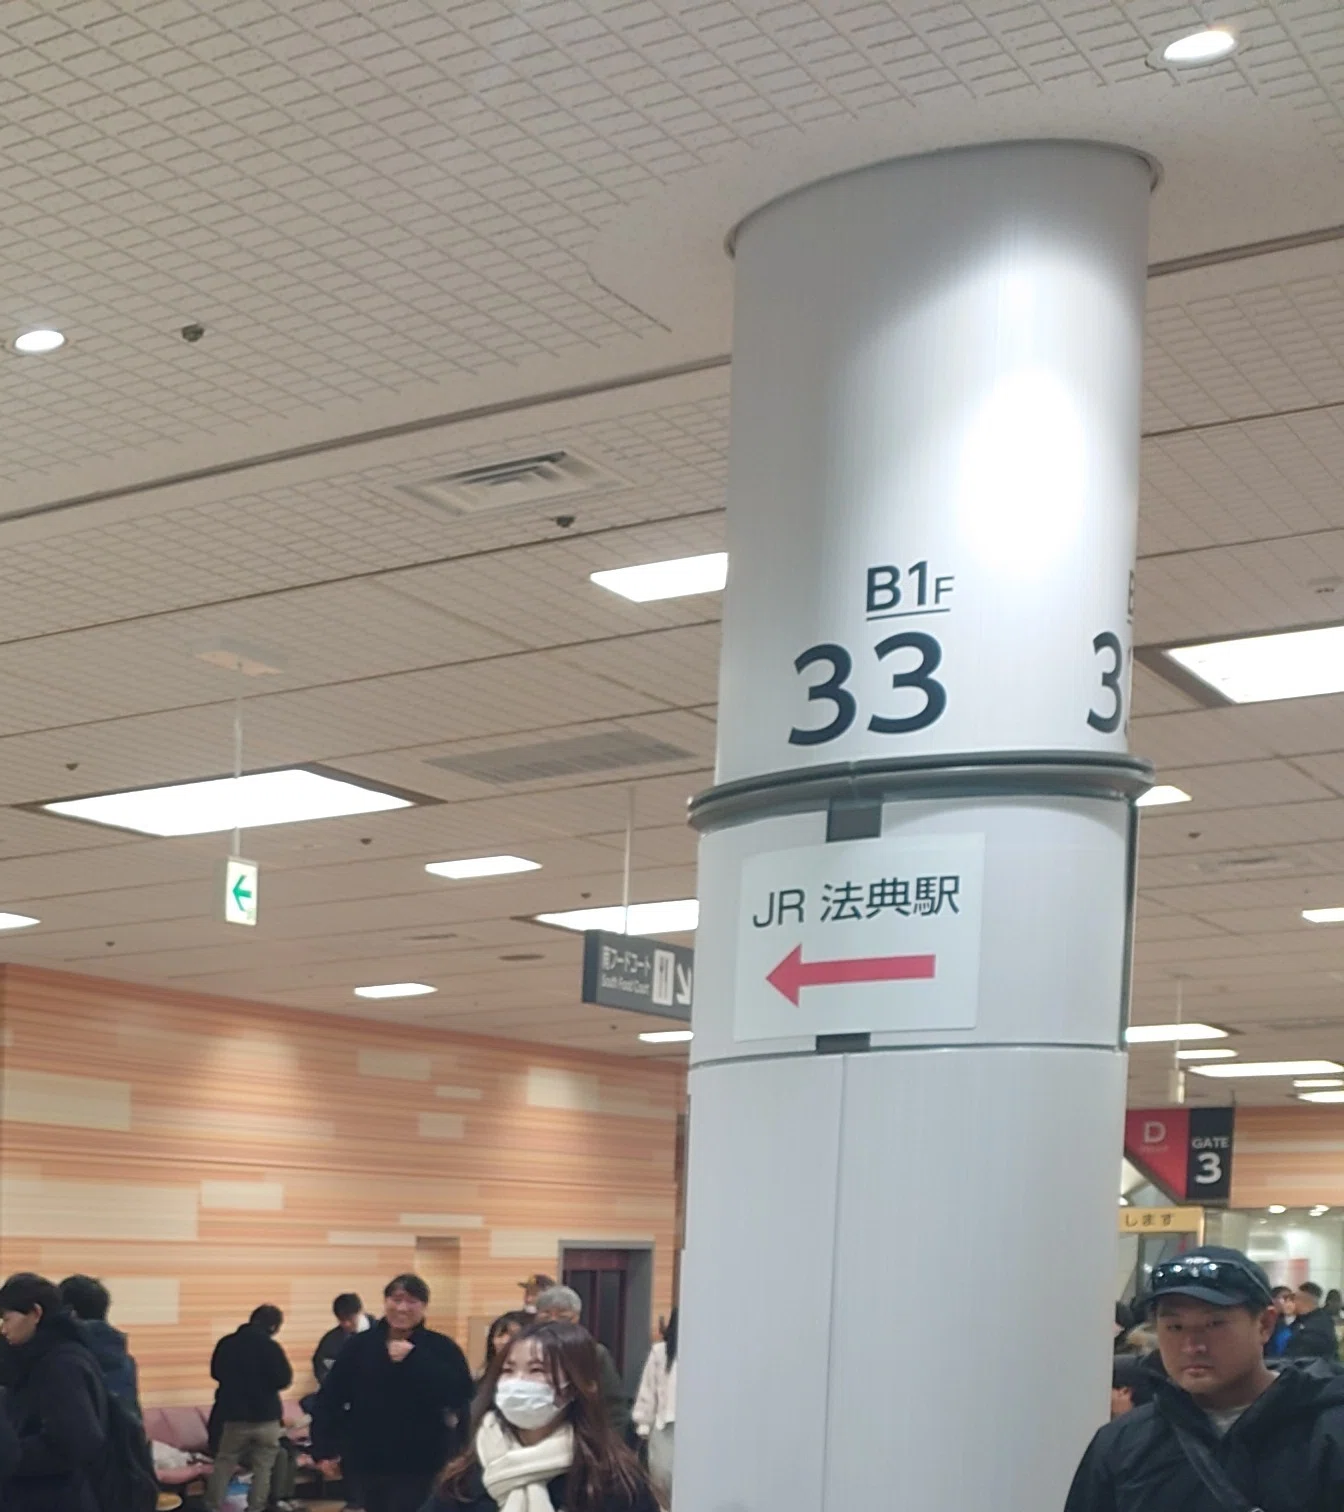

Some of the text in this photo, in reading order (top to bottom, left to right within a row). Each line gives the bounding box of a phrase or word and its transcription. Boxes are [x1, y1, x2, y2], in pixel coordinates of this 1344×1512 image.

[866, 561, 955, 612] B1F
[788, 631, 948, 746] 33
[1086, 631, 1128, 734] 3
[752, 875, 961, 928] JR 法典駅
[1144, 1121, 1166, 1143] D
[1191, 1137, 1230, 1149] GATE
[1195, 1152, 1222, 1184] 3
